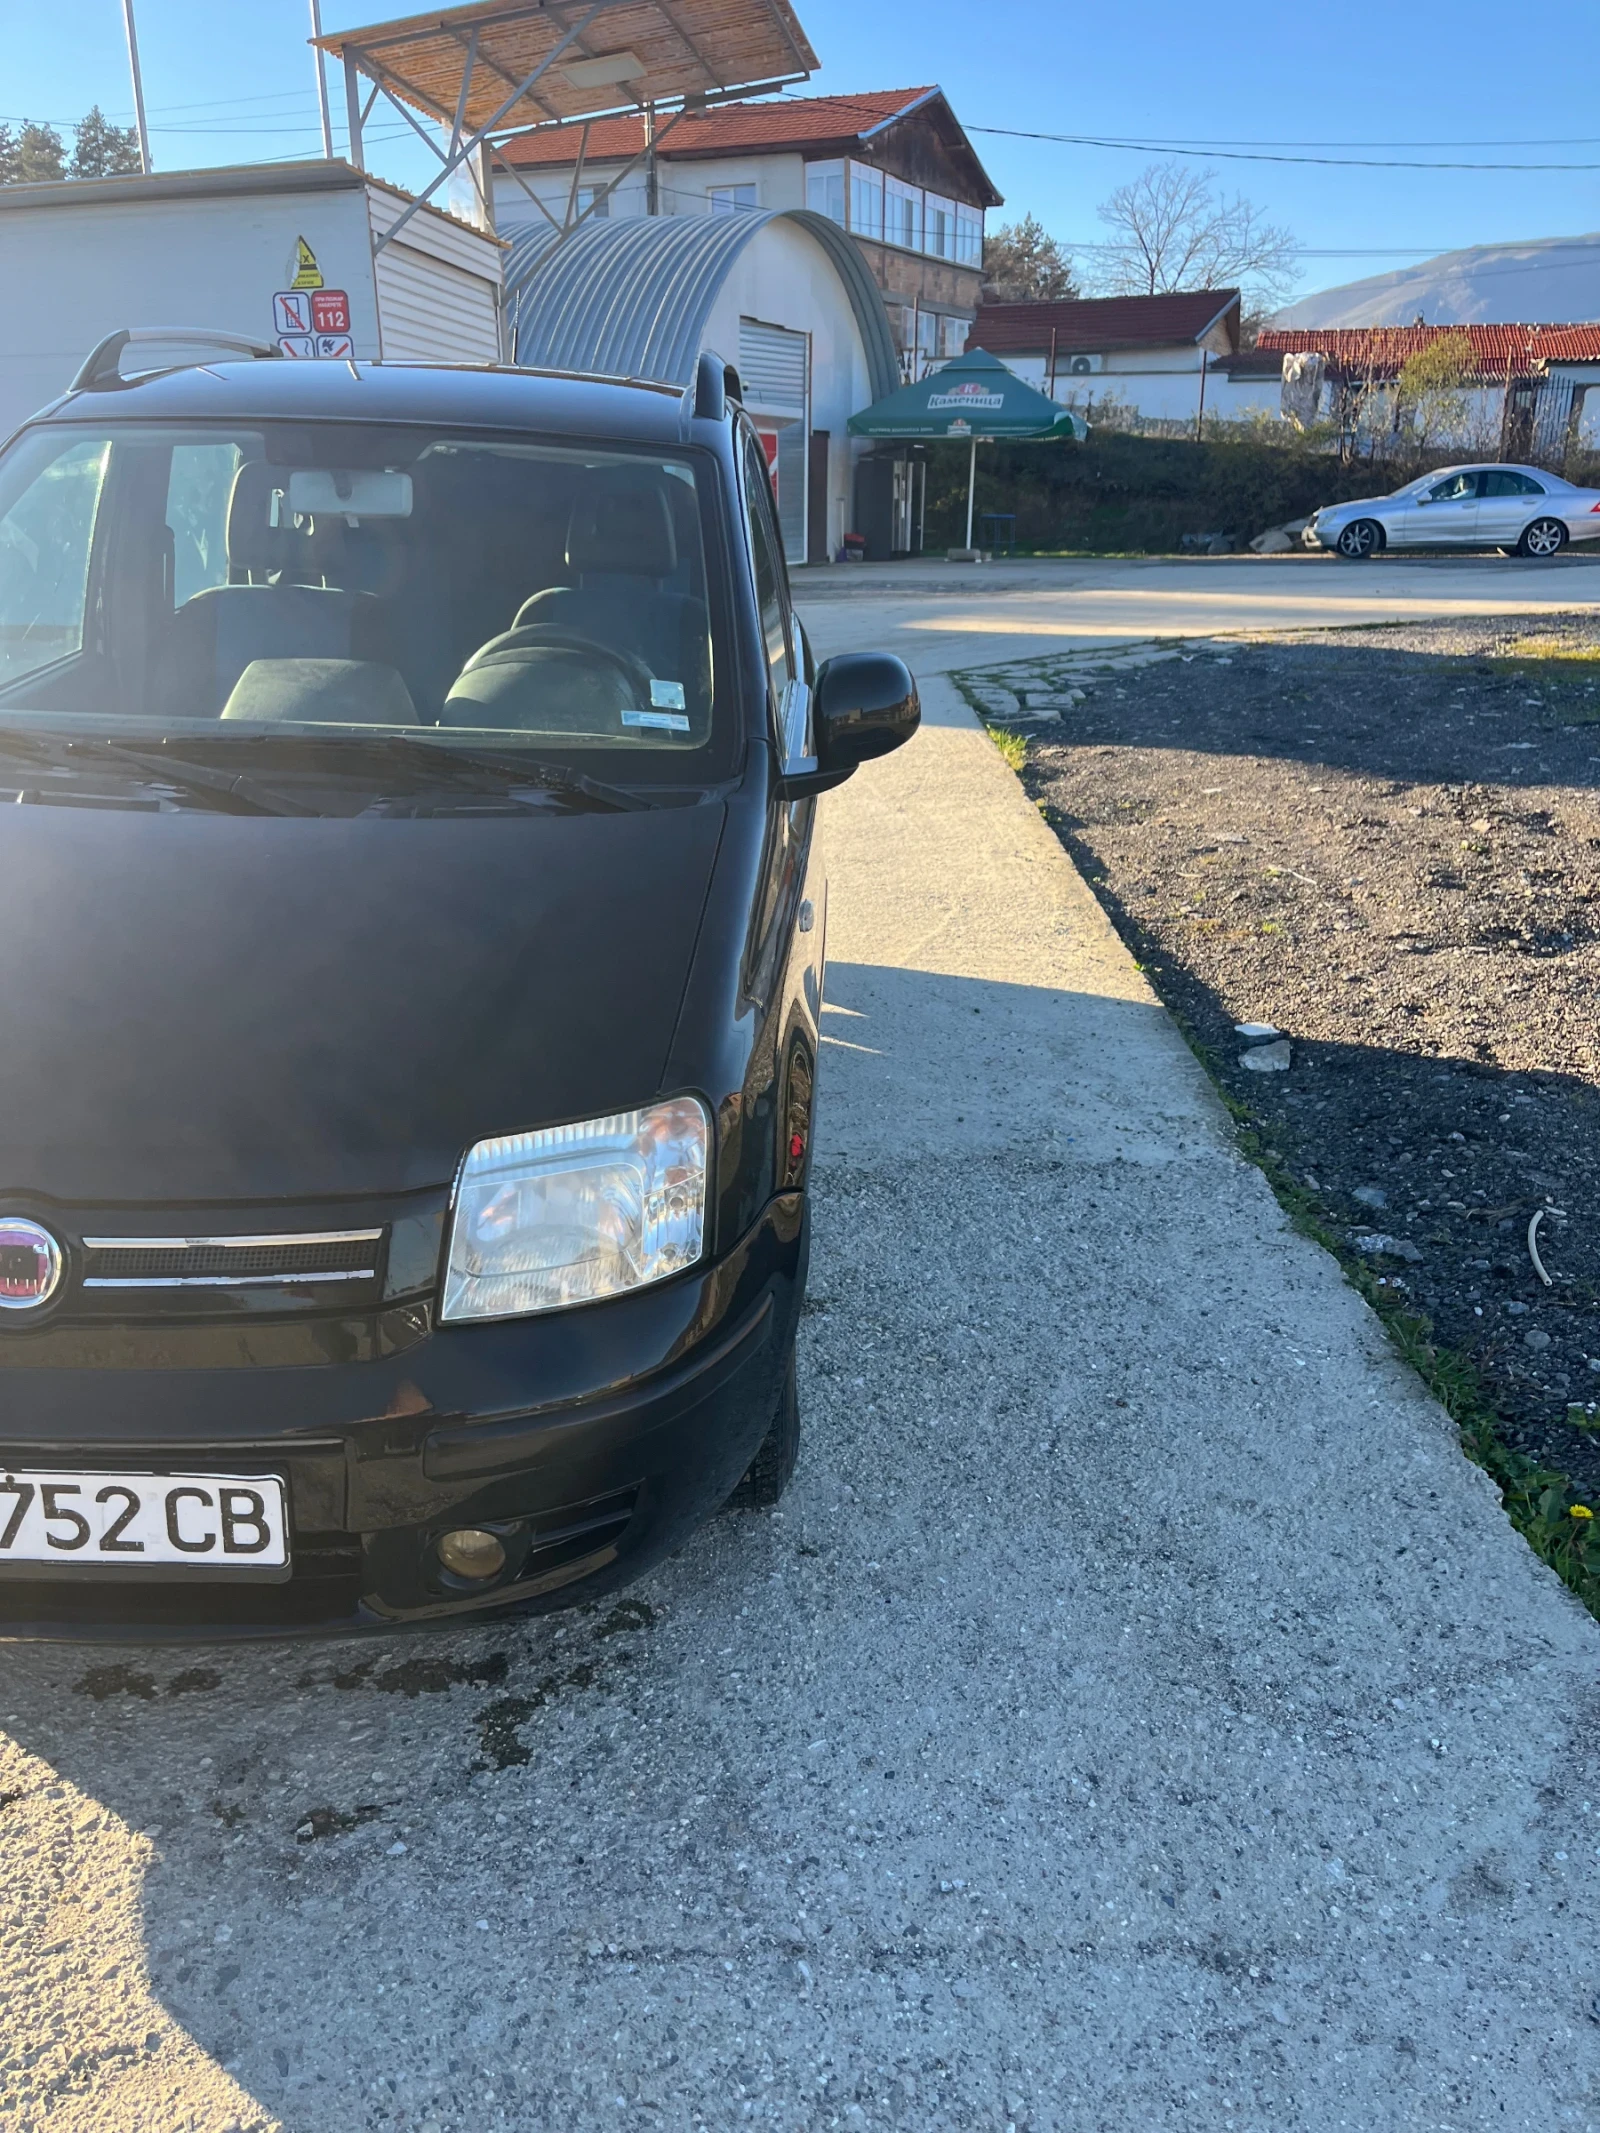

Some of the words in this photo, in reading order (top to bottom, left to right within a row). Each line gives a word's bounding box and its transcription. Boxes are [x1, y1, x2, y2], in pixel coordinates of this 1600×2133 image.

[318, 311, 345, 327] 112
[930, 396, 1001, 407] Каменица
[165, 1487, 271, 1553] CB
